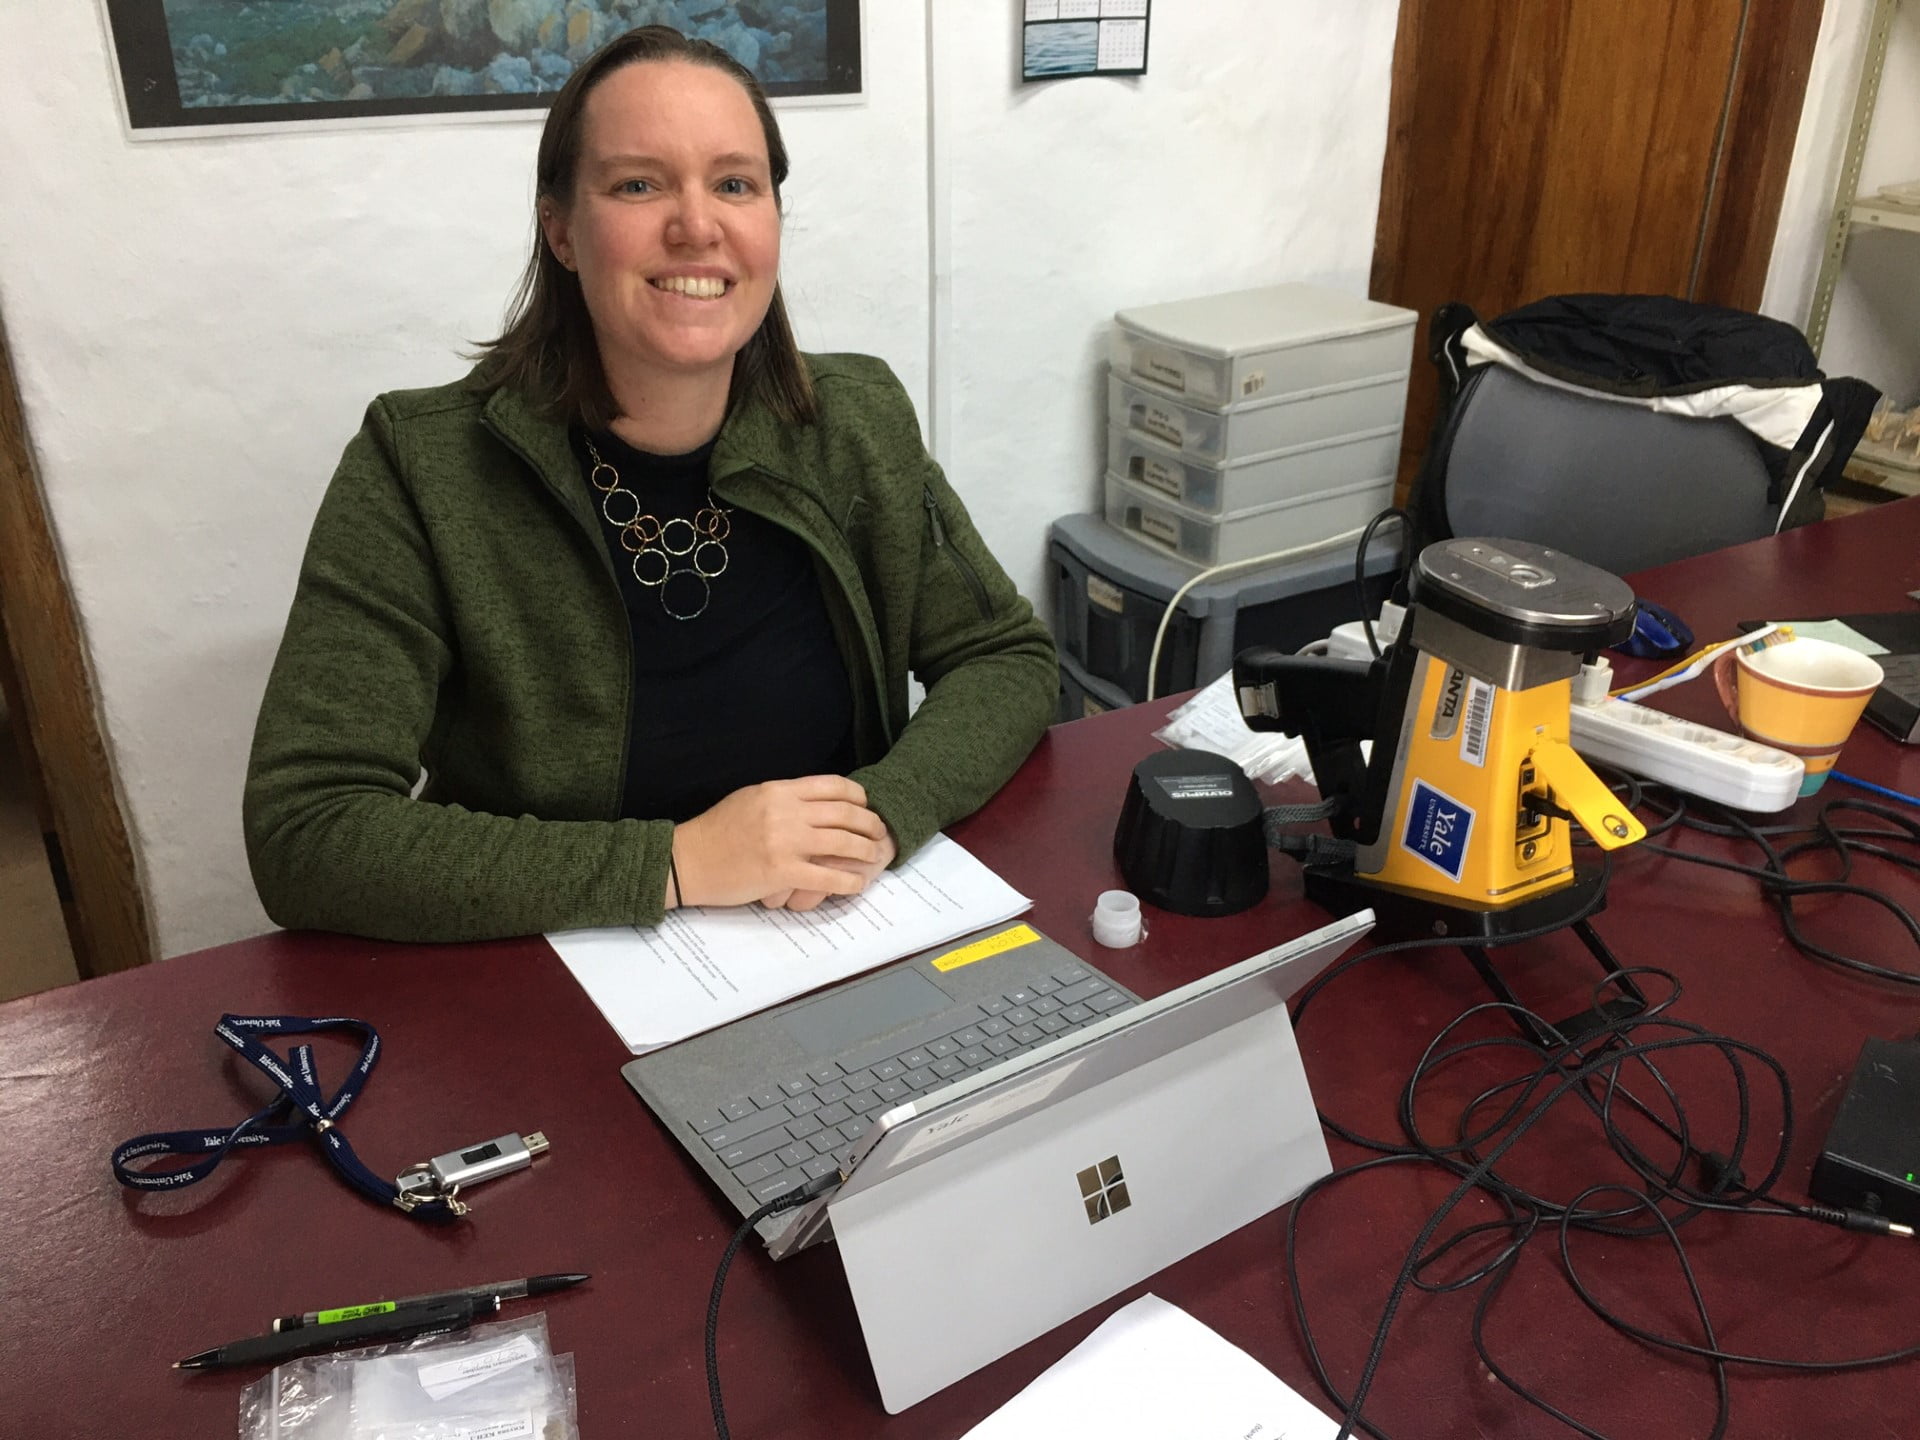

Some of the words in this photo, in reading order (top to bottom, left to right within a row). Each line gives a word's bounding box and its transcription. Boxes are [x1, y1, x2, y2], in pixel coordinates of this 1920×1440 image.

[1171, 790, 1233, 800] OLYMPUS
[1418, 797, 1437, 851] UNIVERSITY
[1430, 807, 1457, 856] Yale
[264, 1018, 281, 1028] Yale
[204, 1136, 221, 1148] Yale
[173, 1171, 194, 1183] Yale
